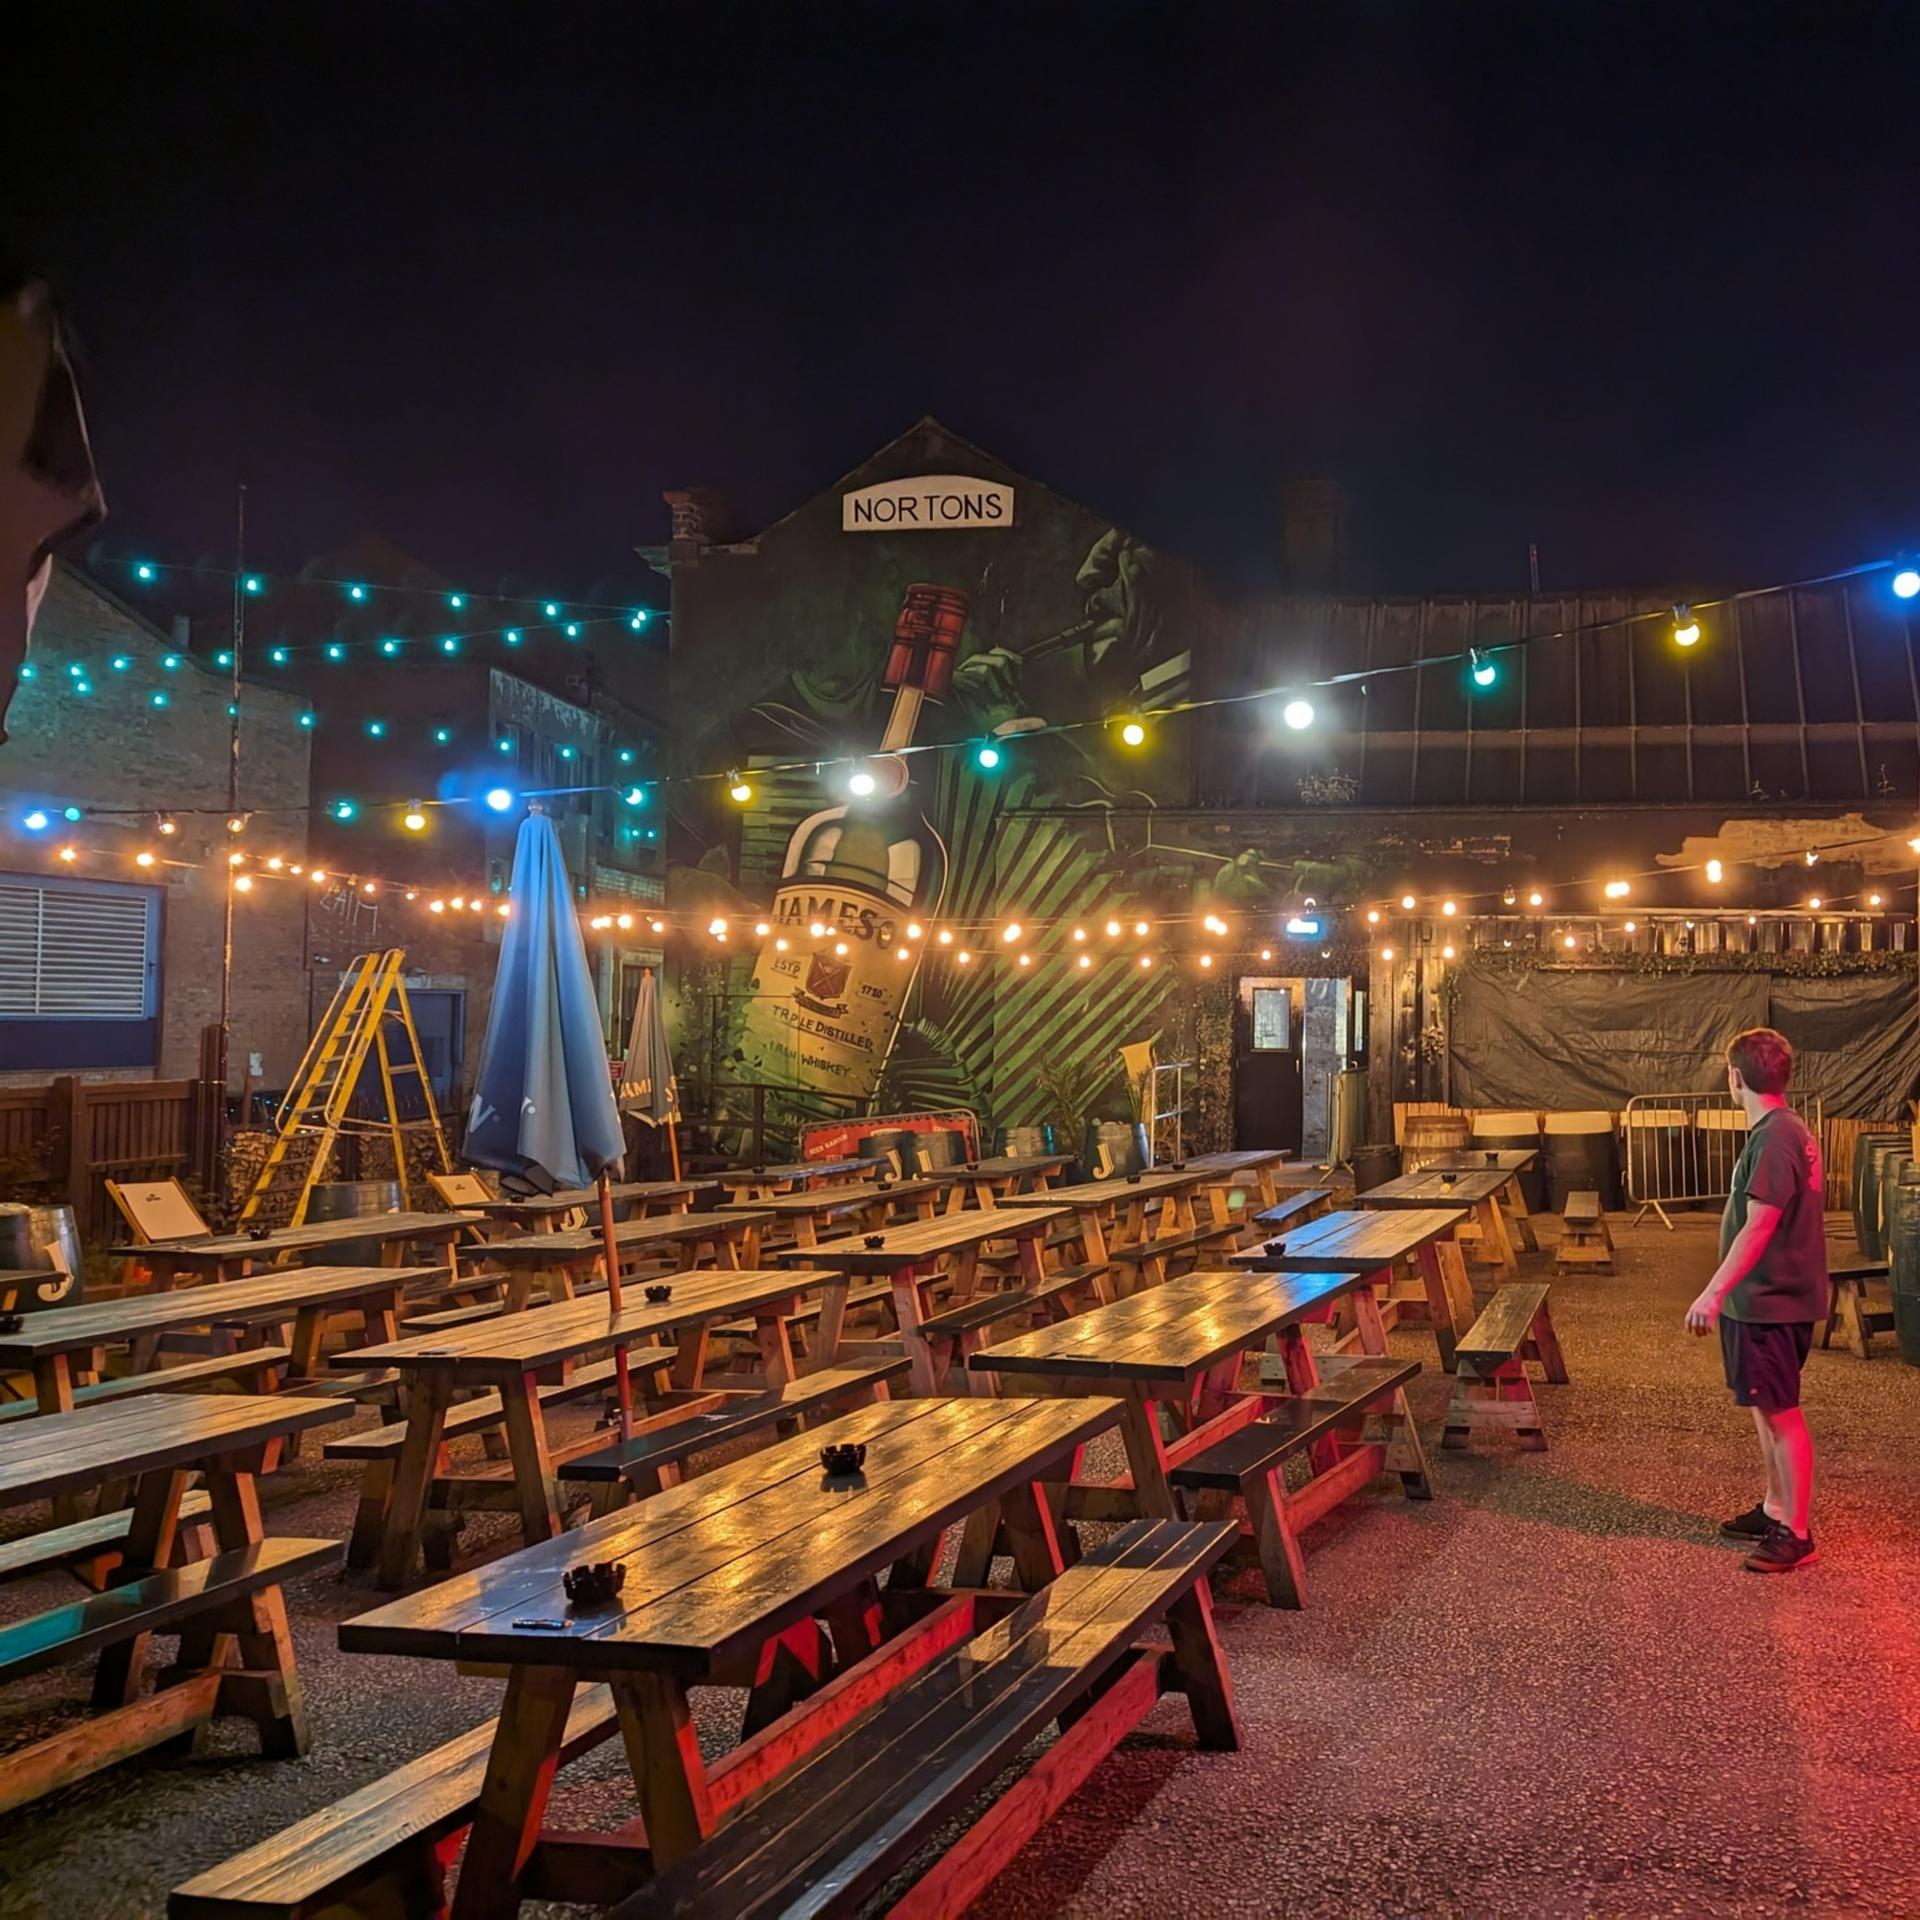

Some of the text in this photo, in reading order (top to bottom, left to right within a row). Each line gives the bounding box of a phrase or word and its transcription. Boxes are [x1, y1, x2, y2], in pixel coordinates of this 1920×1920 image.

[854, 493, 1003, 524] NORTONS
[815, 1021, 874, 1050] DISTILLED
[801, 1053, 851, 1078] WHISKEY
